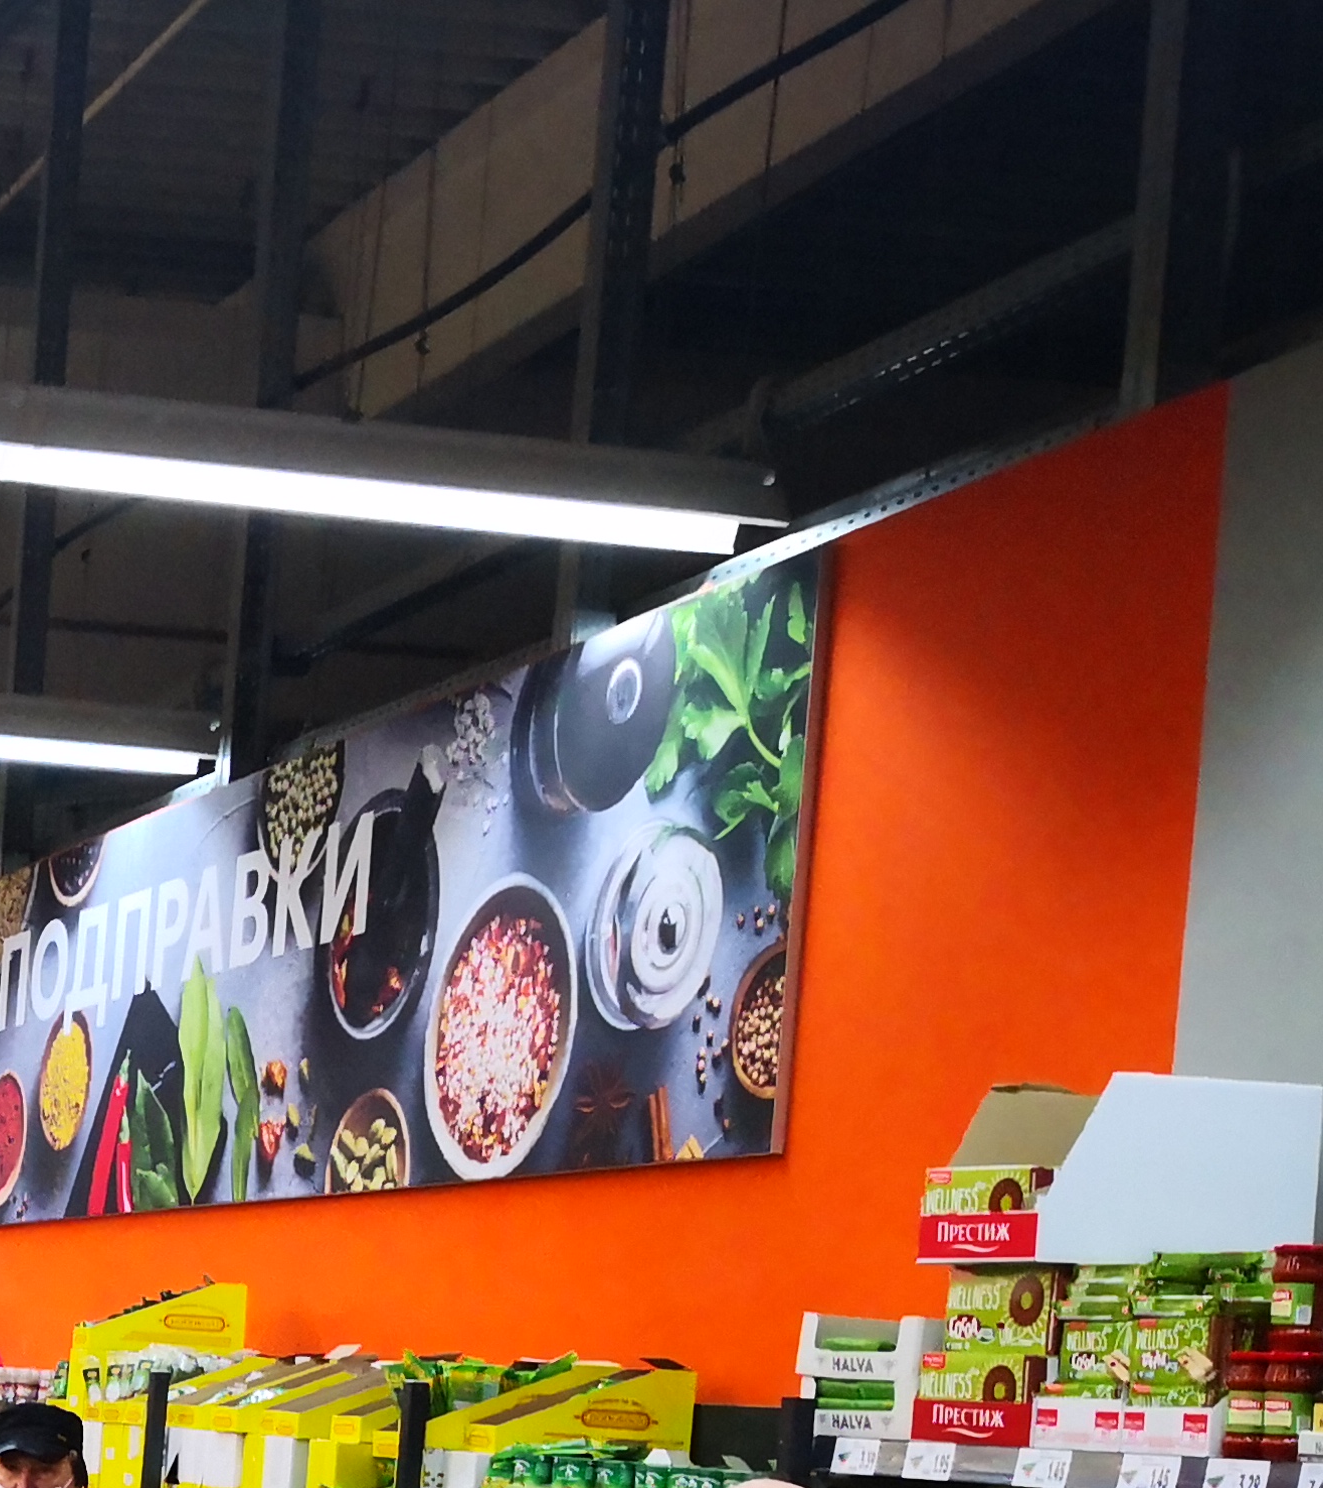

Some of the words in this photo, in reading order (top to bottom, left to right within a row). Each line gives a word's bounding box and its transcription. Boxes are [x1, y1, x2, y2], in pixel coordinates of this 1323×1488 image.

[925, 1186, 980, 1213] WELLNESS
[936, 1221, 1011, 1244] ПРЕСТИЖ
[948, 1283, 1001, 1311] WELLNESS
[832, 1356, 874, 1374] HALVA
[919, 1372, 973, 1400] WELLNESS
[831, 1413, 873, 1430] HALVA
[931, 1403, 1006, 1429] ПРЕСТИЖ
